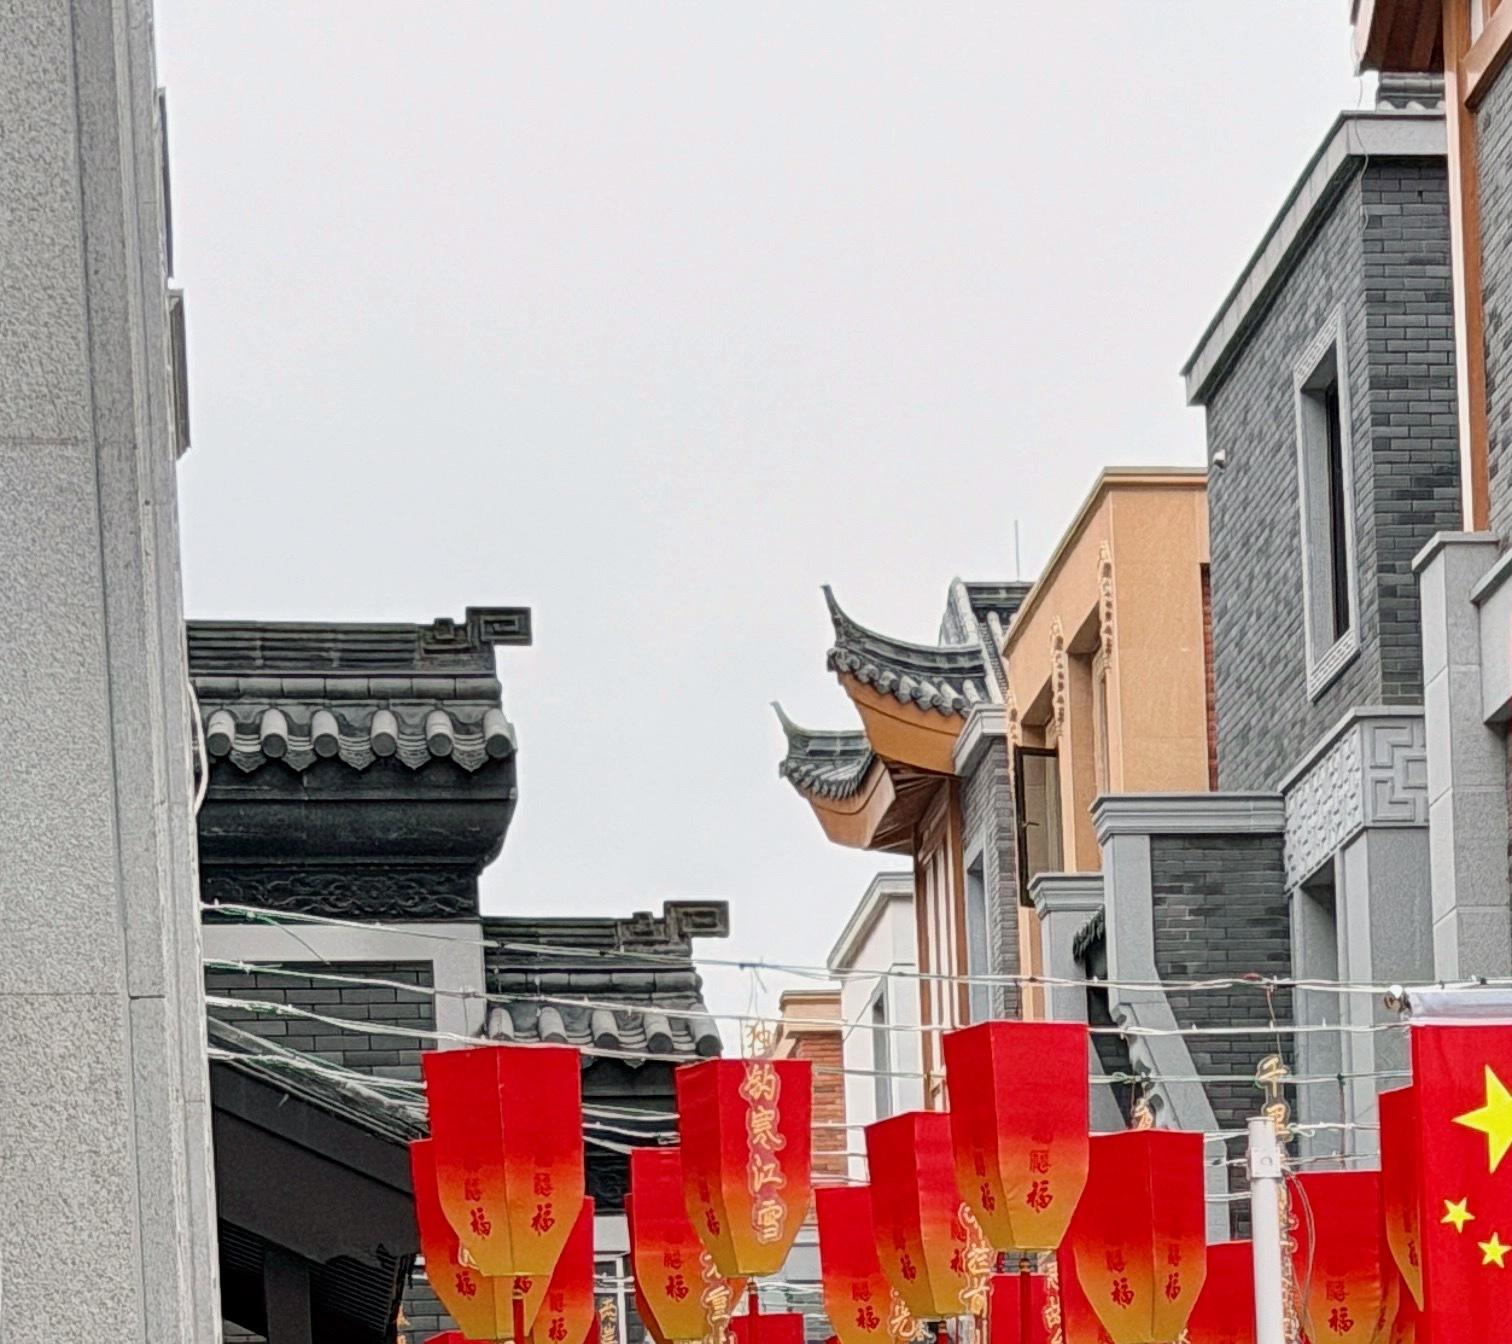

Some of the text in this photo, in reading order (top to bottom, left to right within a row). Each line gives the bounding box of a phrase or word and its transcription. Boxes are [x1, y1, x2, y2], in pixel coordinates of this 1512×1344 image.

[744, 1019, 782, 1239] 独钓寒江雪
[1027, 1180, 1053, 1213] 福
[471, 1207, 492, 1239] 福
[531, 1203, 555, 1236] 福
[455, 1271, 477, 1300] 福
[666, 1275, 689, 1302] 福
[1111, 1278, 1134, 1309] 福
[549, 1317, 568, 1344] 福
[856, 1306, 880, 1332] 福
[1328, 1307, 1354, 1336] 福
